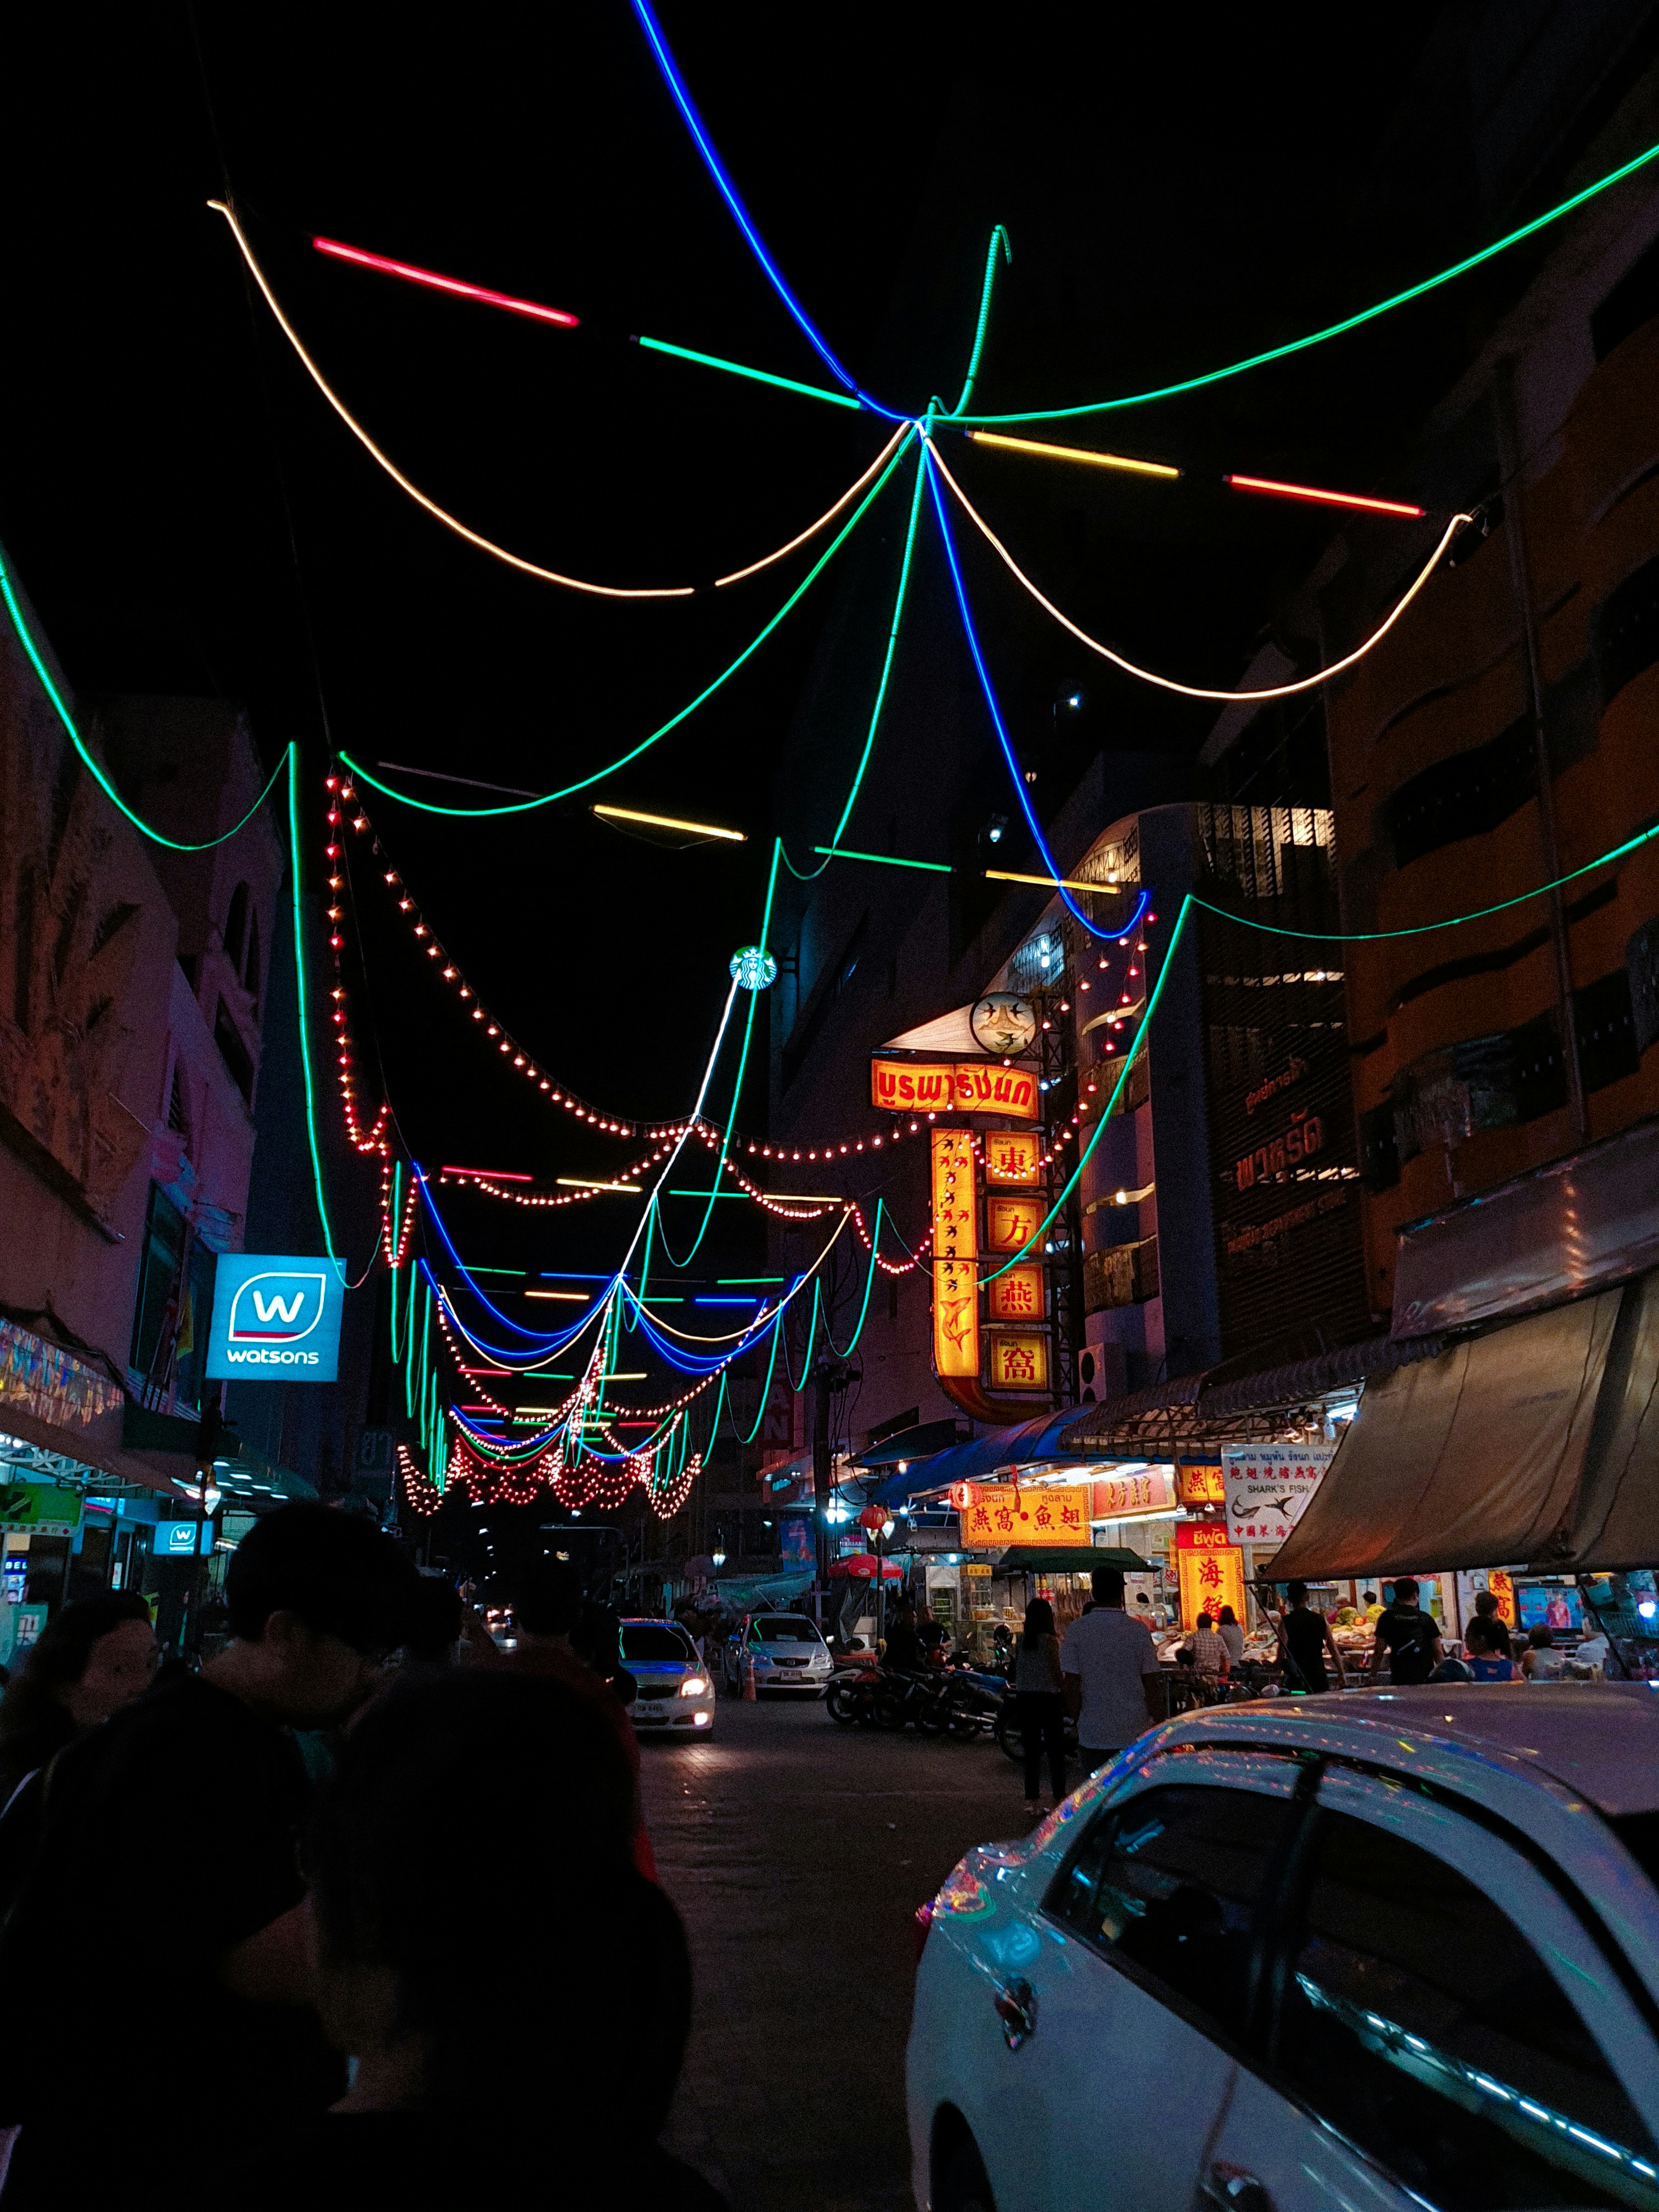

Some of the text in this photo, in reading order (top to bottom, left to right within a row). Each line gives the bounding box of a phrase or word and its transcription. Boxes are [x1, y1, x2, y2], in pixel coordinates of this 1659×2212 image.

[1001, 1214, 1031, 1245] 方
[1000, 1280, 1032, 1311] 燕
[227, 1348, 319, 1365] watsons
[1002, 1347, 1035, 1381] 窩
[1248, 1485, 1310, 1493] SHARK'S FISH
